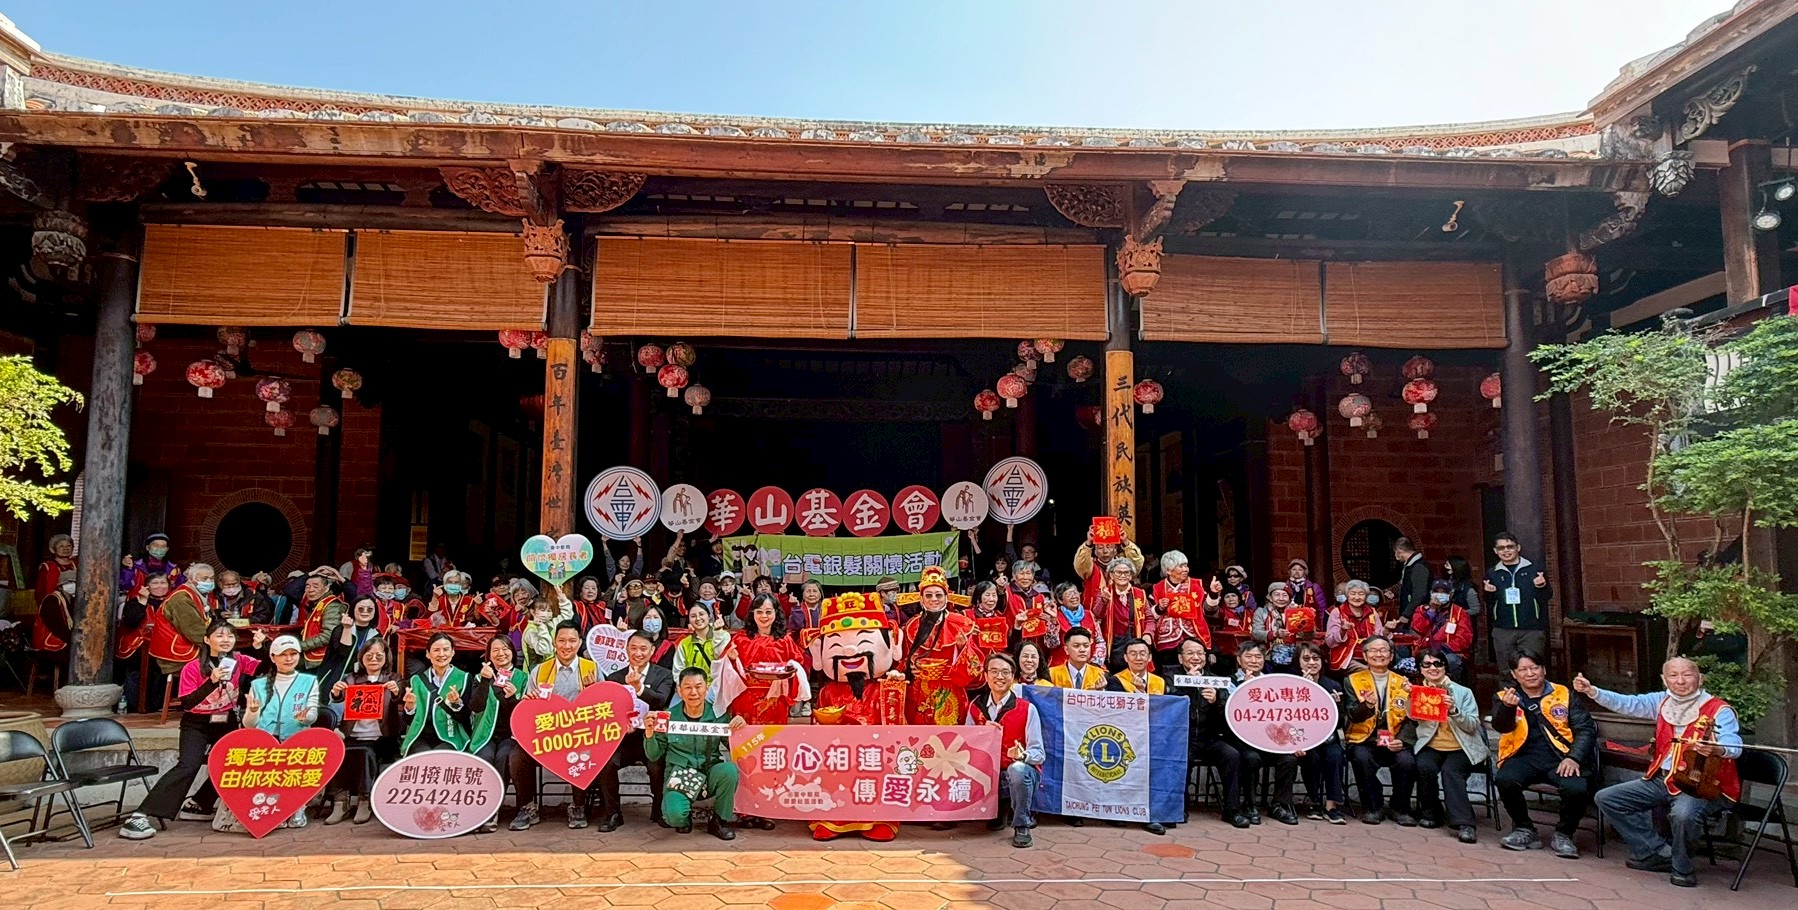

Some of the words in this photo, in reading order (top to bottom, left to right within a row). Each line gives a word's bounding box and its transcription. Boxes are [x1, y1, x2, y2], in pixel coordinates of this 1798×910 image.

[1112, 375, 1133, 526] 三代民族英
[709, 489, 937, 532] 華山基金會
[783, 550, 943, 576] 台電銀髮關懷活動
[606, 649, 629, 662] 關心
[1067, 692, 1146, 711] 台中市北屯獅子會
[1248, 687, 1312, 703] 愛心專線
[534, 701, 615, 733] 愛心年菜
[1234, 708, 1330, 722] 04-24734843
[532, 721, 621, 756] 1000元/份
[741, 732, 766, 753] 115年
[1089, 726, 1123, 741] LIONS
[224, 747, 328, 767] 獨老年夜飯
[762, 744, 882, 773] 郵心相連
[1100, 742, 1115, 763] L
[220, 769, 323, 788] 由你來添愛
[399, 765, 484, 786] 劃撥帳號
[386, 788, 488, 806] 22542465
[852, 775, 972, 805] 傳愛永續
[1065, 800, 1089, 811] TAICHUNG
[1091, 803, 1100, 812] PEI
[1102, 804, 1112, 813] TUN
[1115, 804, 1130, 815] LIONS
[1132, 806, 1146, 816] CLUB
